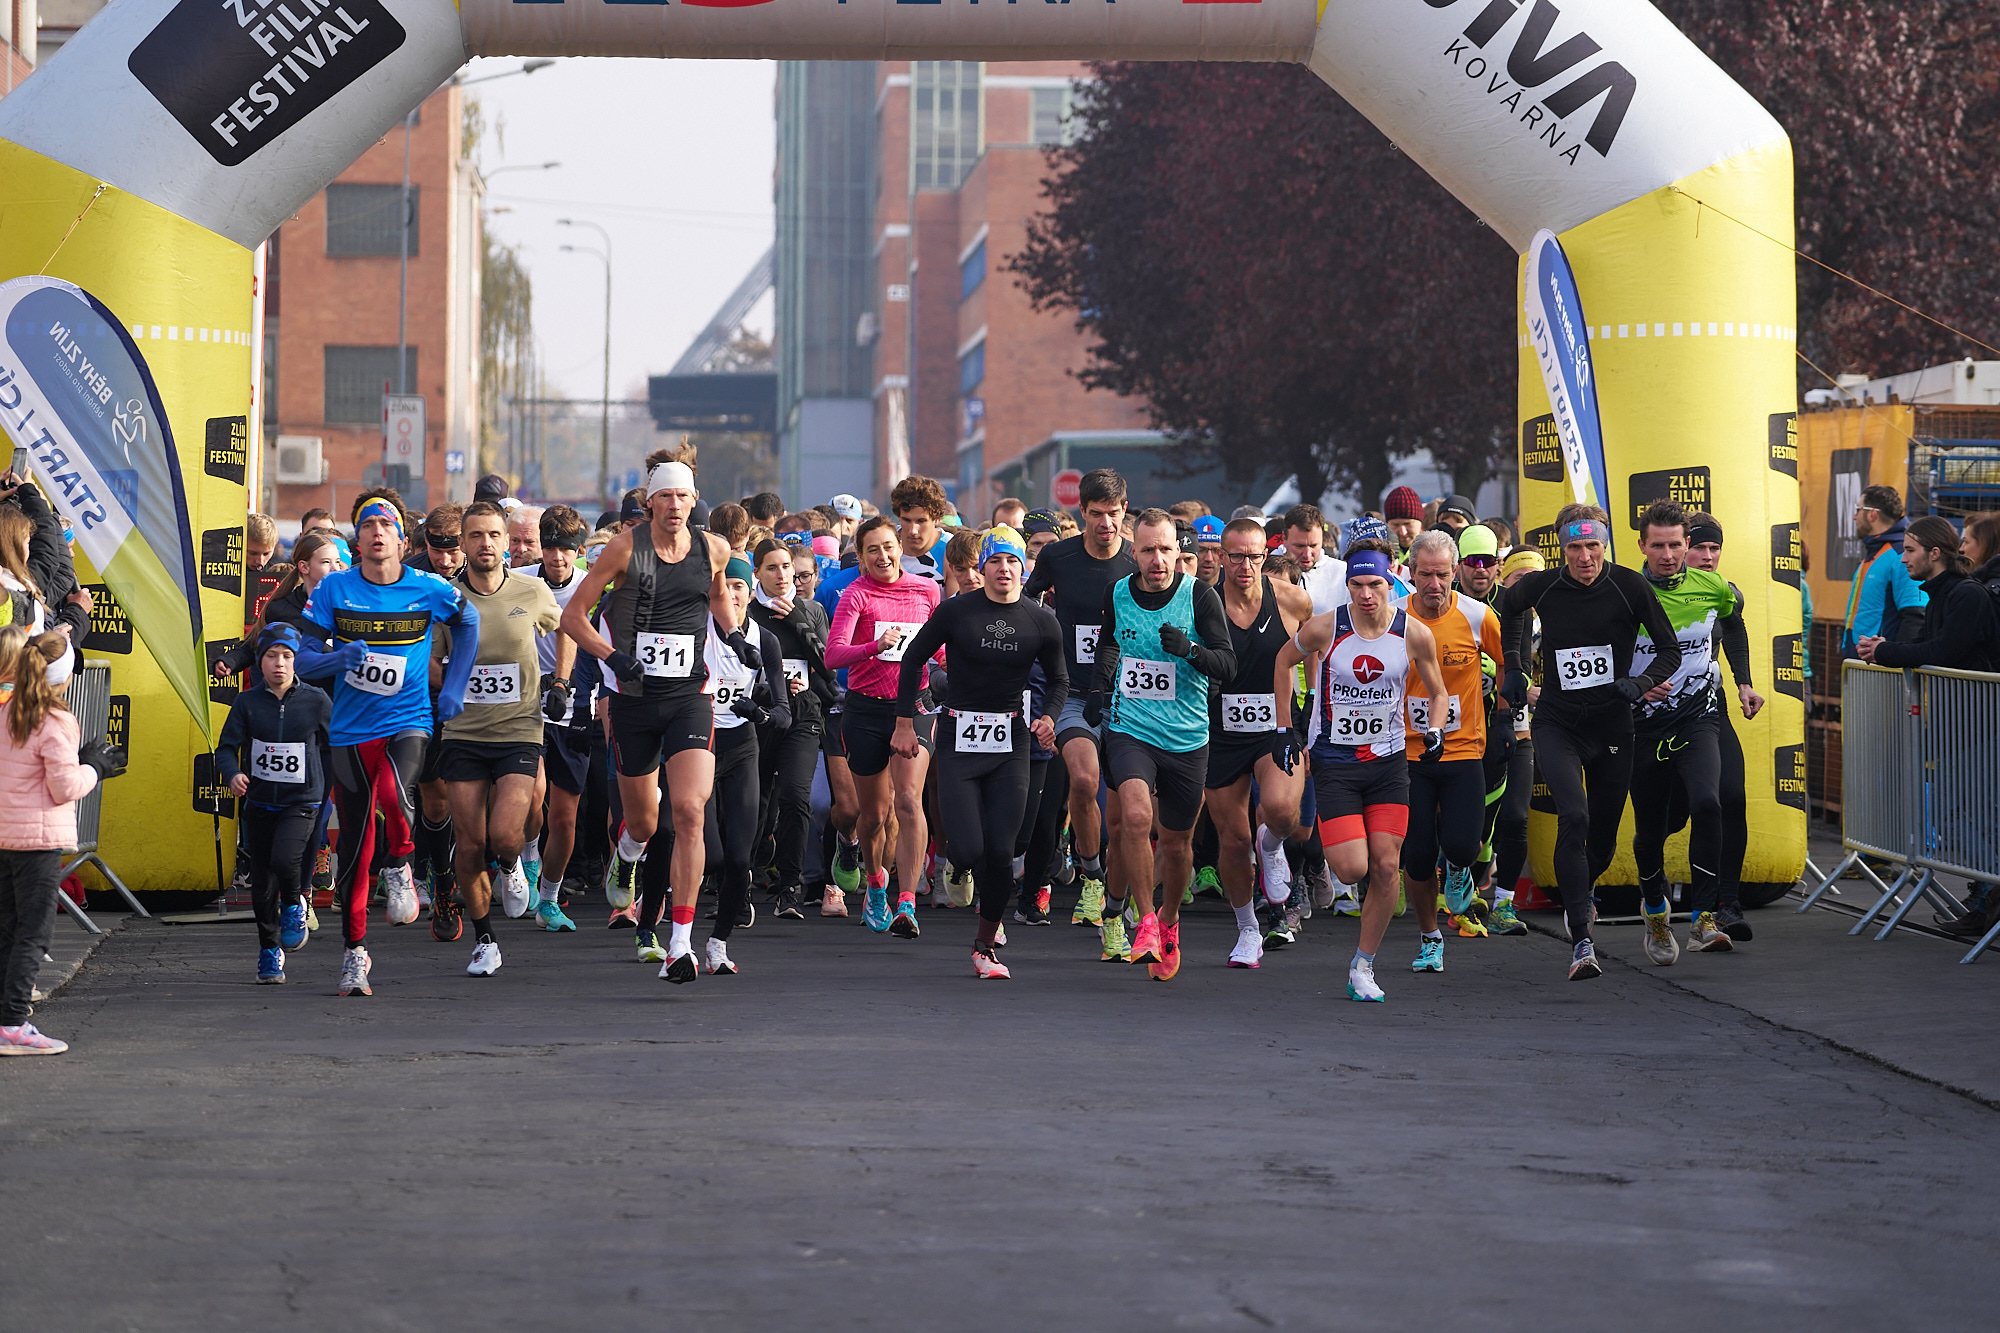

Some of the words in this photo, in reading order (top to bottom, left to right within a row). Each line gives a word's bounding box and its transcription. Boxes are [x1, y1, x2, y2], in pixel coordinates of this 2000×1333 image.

[210, 6, 371, 148] FESTIVAL
[1423, 0, 1637, 158] IVA
[1443, 38, 1582, 166] KOVÁRNA
[231, 421, 245, 437] ZLÍN
[1536, 419, 1558, 435] ZLÍN
[230, 437, 245, 451] FILM
[1536, 436, 1559, 450] FILM
[1787, 432, 1797, 446] FIL
[209, 450, 245, 466] FESTIVAL
[1524, 449, 1560, 465] FESTIVAL
[1669, 473, 1705, 488] ZLÍN
[1669, 489, 1705, 503] FILM
[1569, 523, 1593, 537] K5
[227, 533, 242, 548] ZLÍN
[226, 548, 242, 563] FILM
[1790, 543, 1800, 557] FIL
[206, 562, 241, 577] FESTIVAL
[91, 591, 118, 604] ZLÍ
[90, 605, 127, 619] FILM
[90, 620, 127, 634] IVAL
[980, 638, 1018, 652] kilpi
[641, 645, 685, 667] 311
[1571, 651, 1582, 659] K5
[1792, 654, 1803, 668] FIL
[478, 668, 489, 676] K5
[1135, 662, 1146, 670] K5
[1563, 657, 1608, 680] 398
[208, 674, 238, 688] ESTIVAL
[351, 663, 397, 687] 400
[1125, 670, 1170, 691] 336
[469, 676, 514, 694] 333
[1332, 683, 1393, 700] PROefekt
[712, 687, 745, 704] 95
[1228, 705, 1272, 723] 363
[1349, 709, 1360, 717] K5
[962, 724, 1007, 743] 476
[1337, 717, 1384, 736] 306
[256, 753, 300, 773] 458
